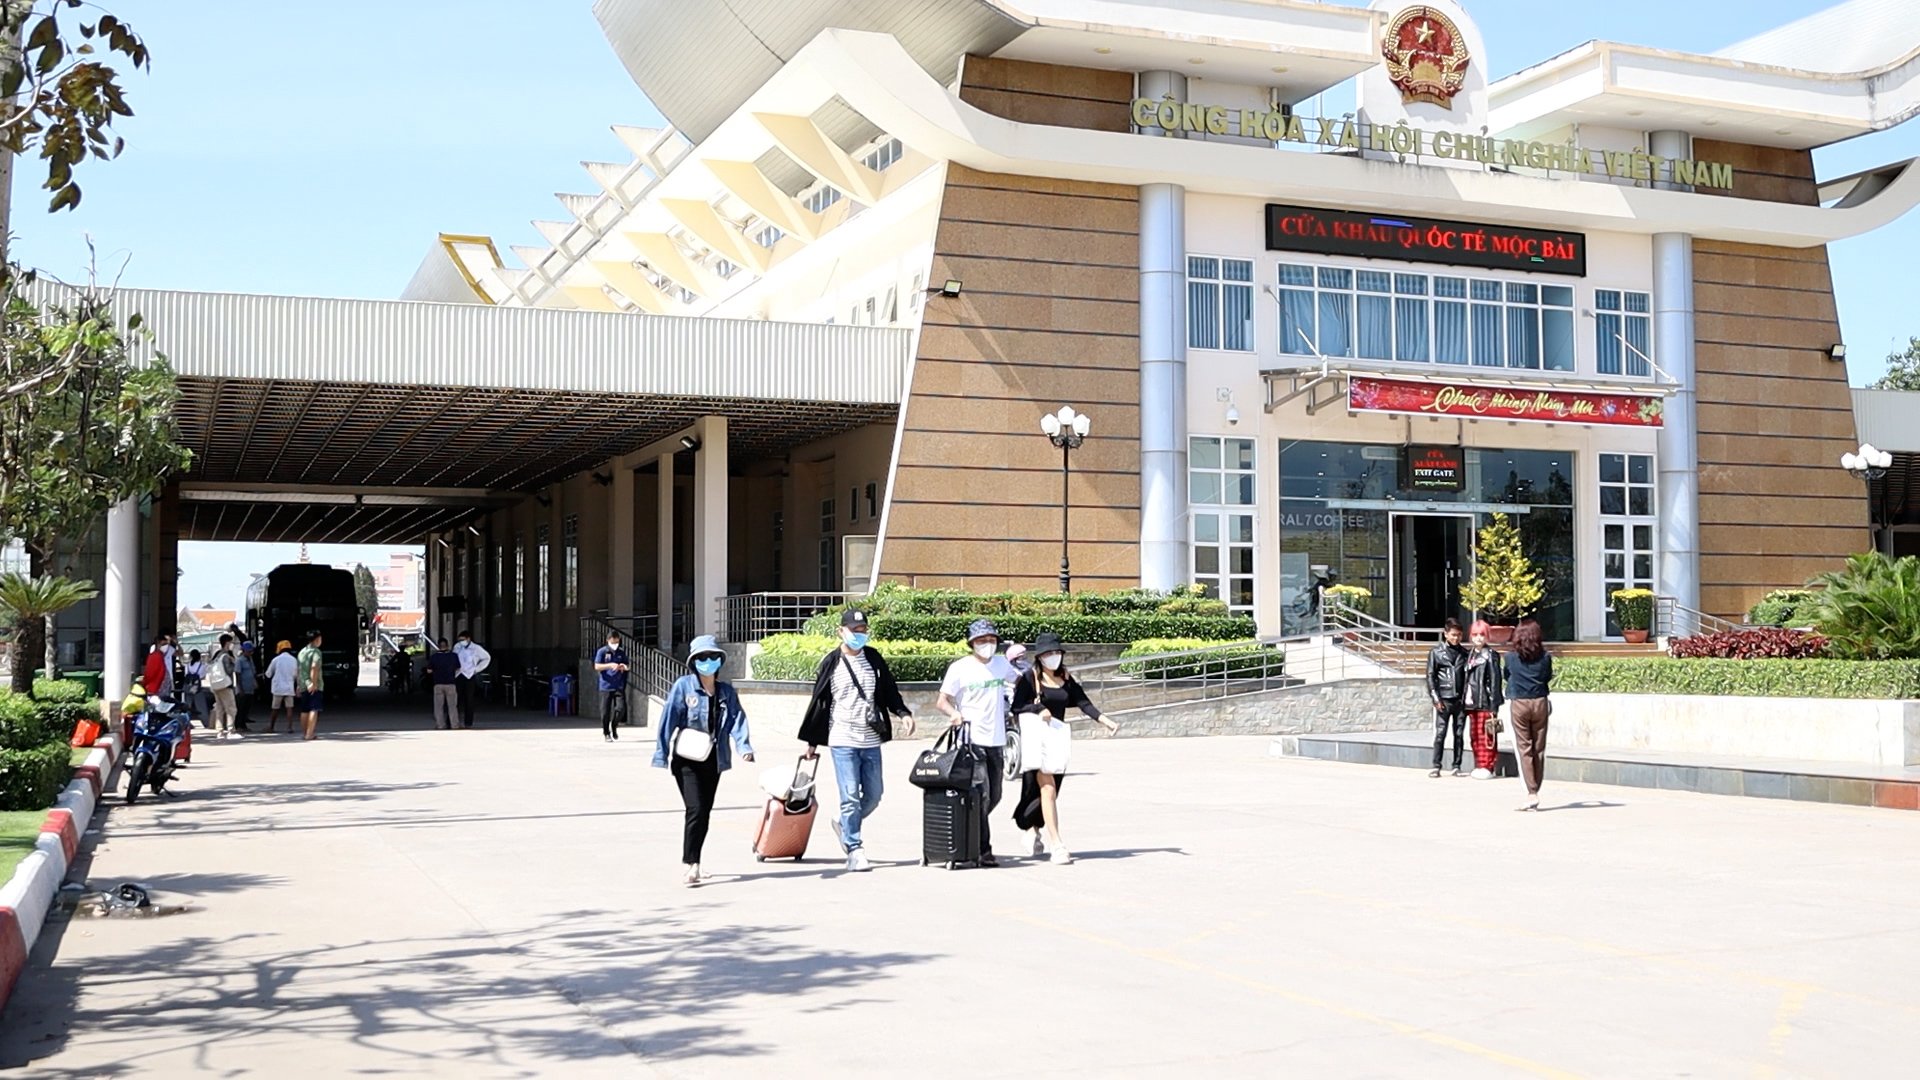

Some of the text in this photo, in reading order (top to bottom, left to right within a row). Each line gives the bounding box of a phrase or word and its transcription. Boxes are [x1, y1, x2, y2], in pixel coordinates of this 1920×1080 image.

[1132, 92, 1733, 189] CỘNG HÒA XÃ HỘI CHỦ NGHĨA VIỆT NAM
[1542, 236, 1576, 260] BÀI
